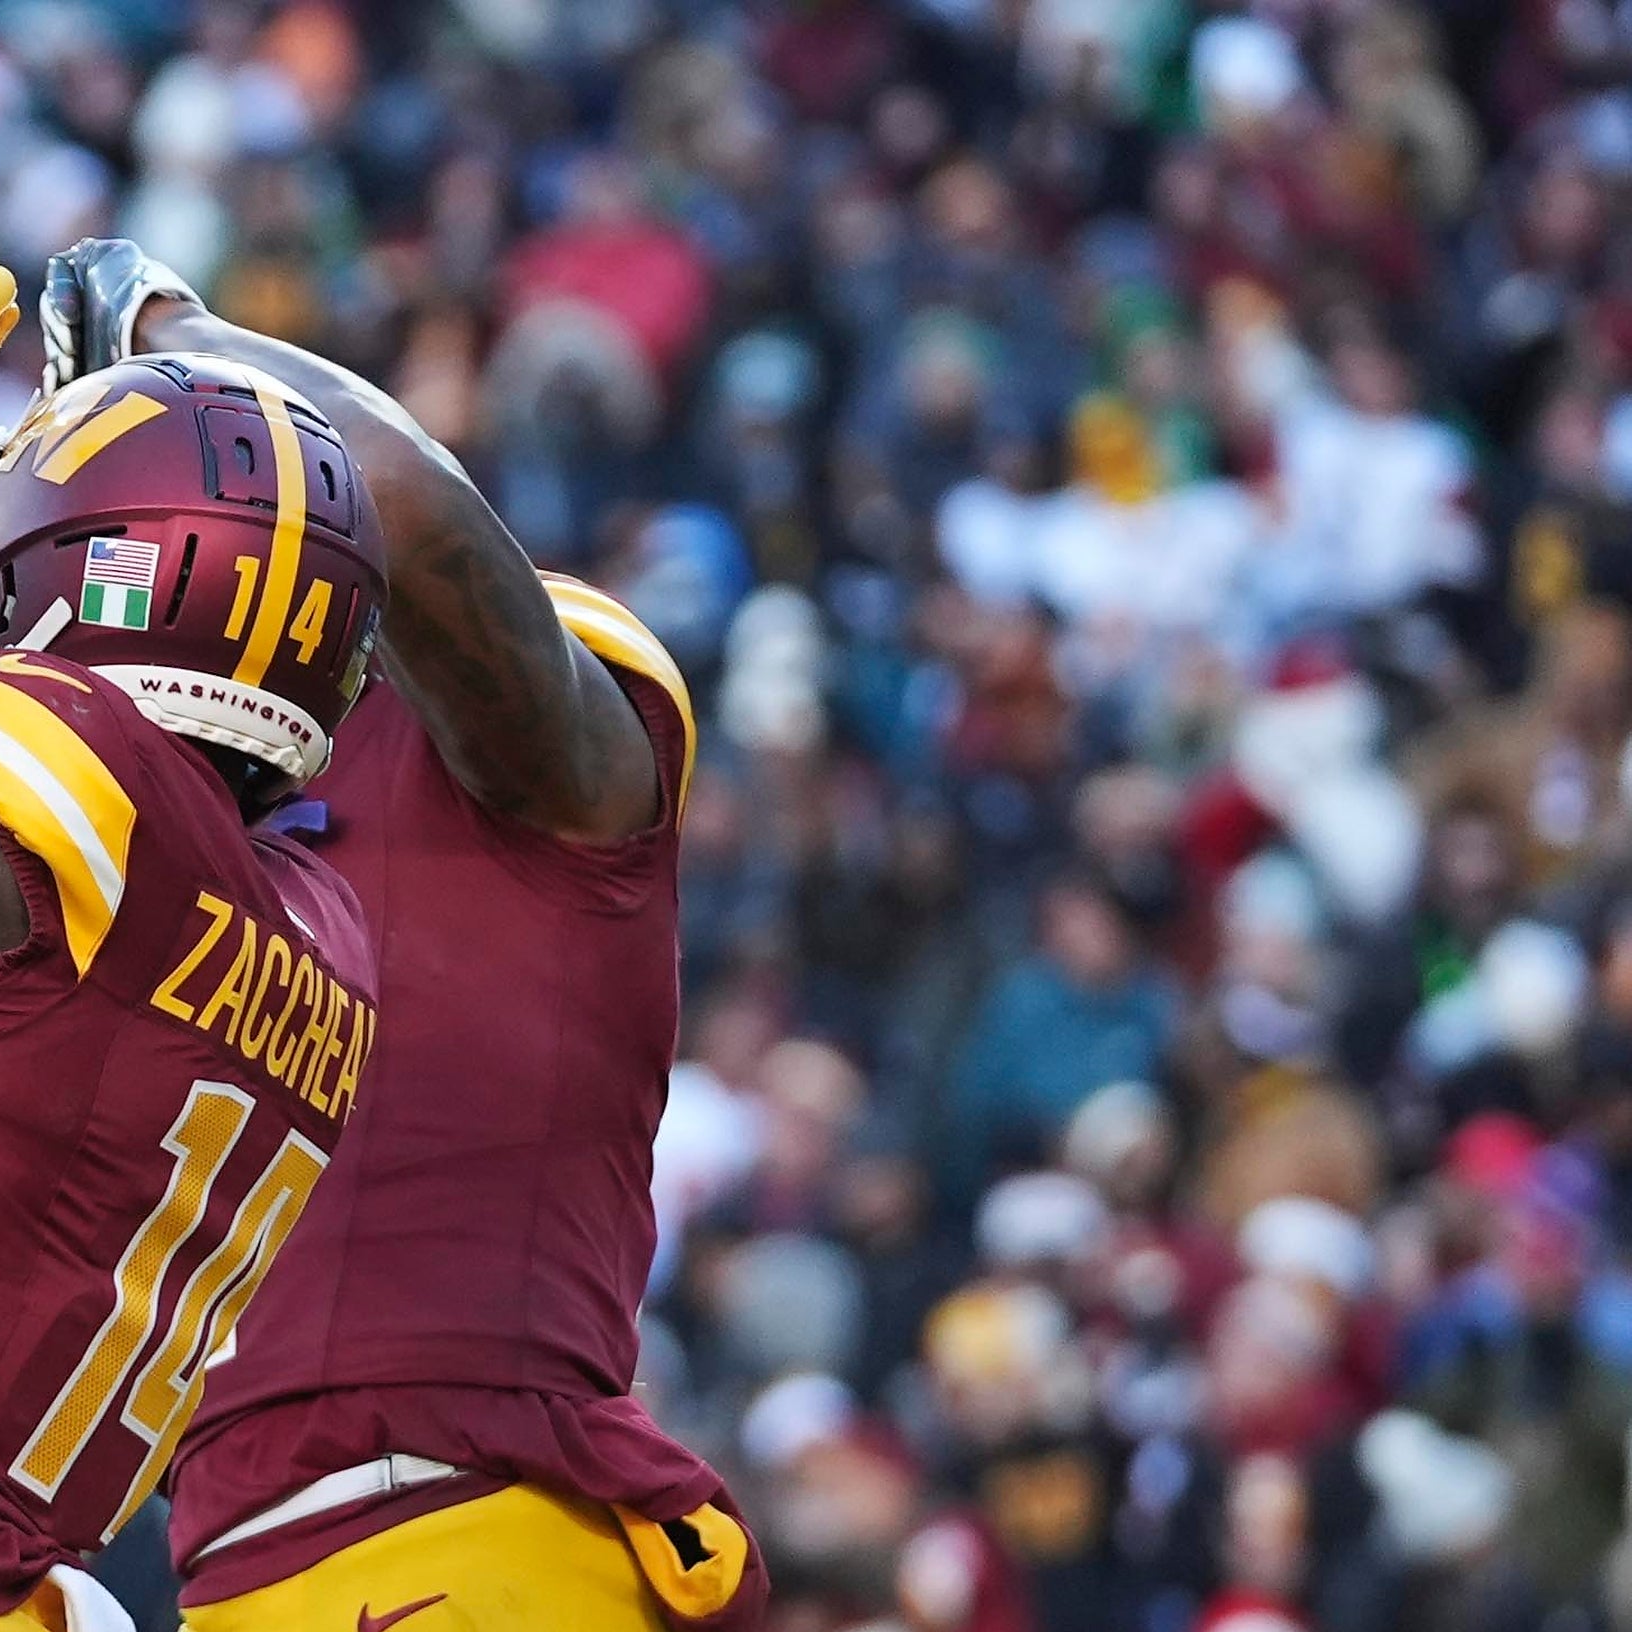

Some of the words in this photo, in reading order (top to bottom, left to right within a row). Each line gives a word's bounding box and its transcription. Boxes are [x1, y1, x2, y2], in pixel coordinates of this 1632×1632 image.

[223, 555, 333, 665] 14
[140, 677, 312, 743] WASHINGTON
[8, 1079, 331, 1546] 14
